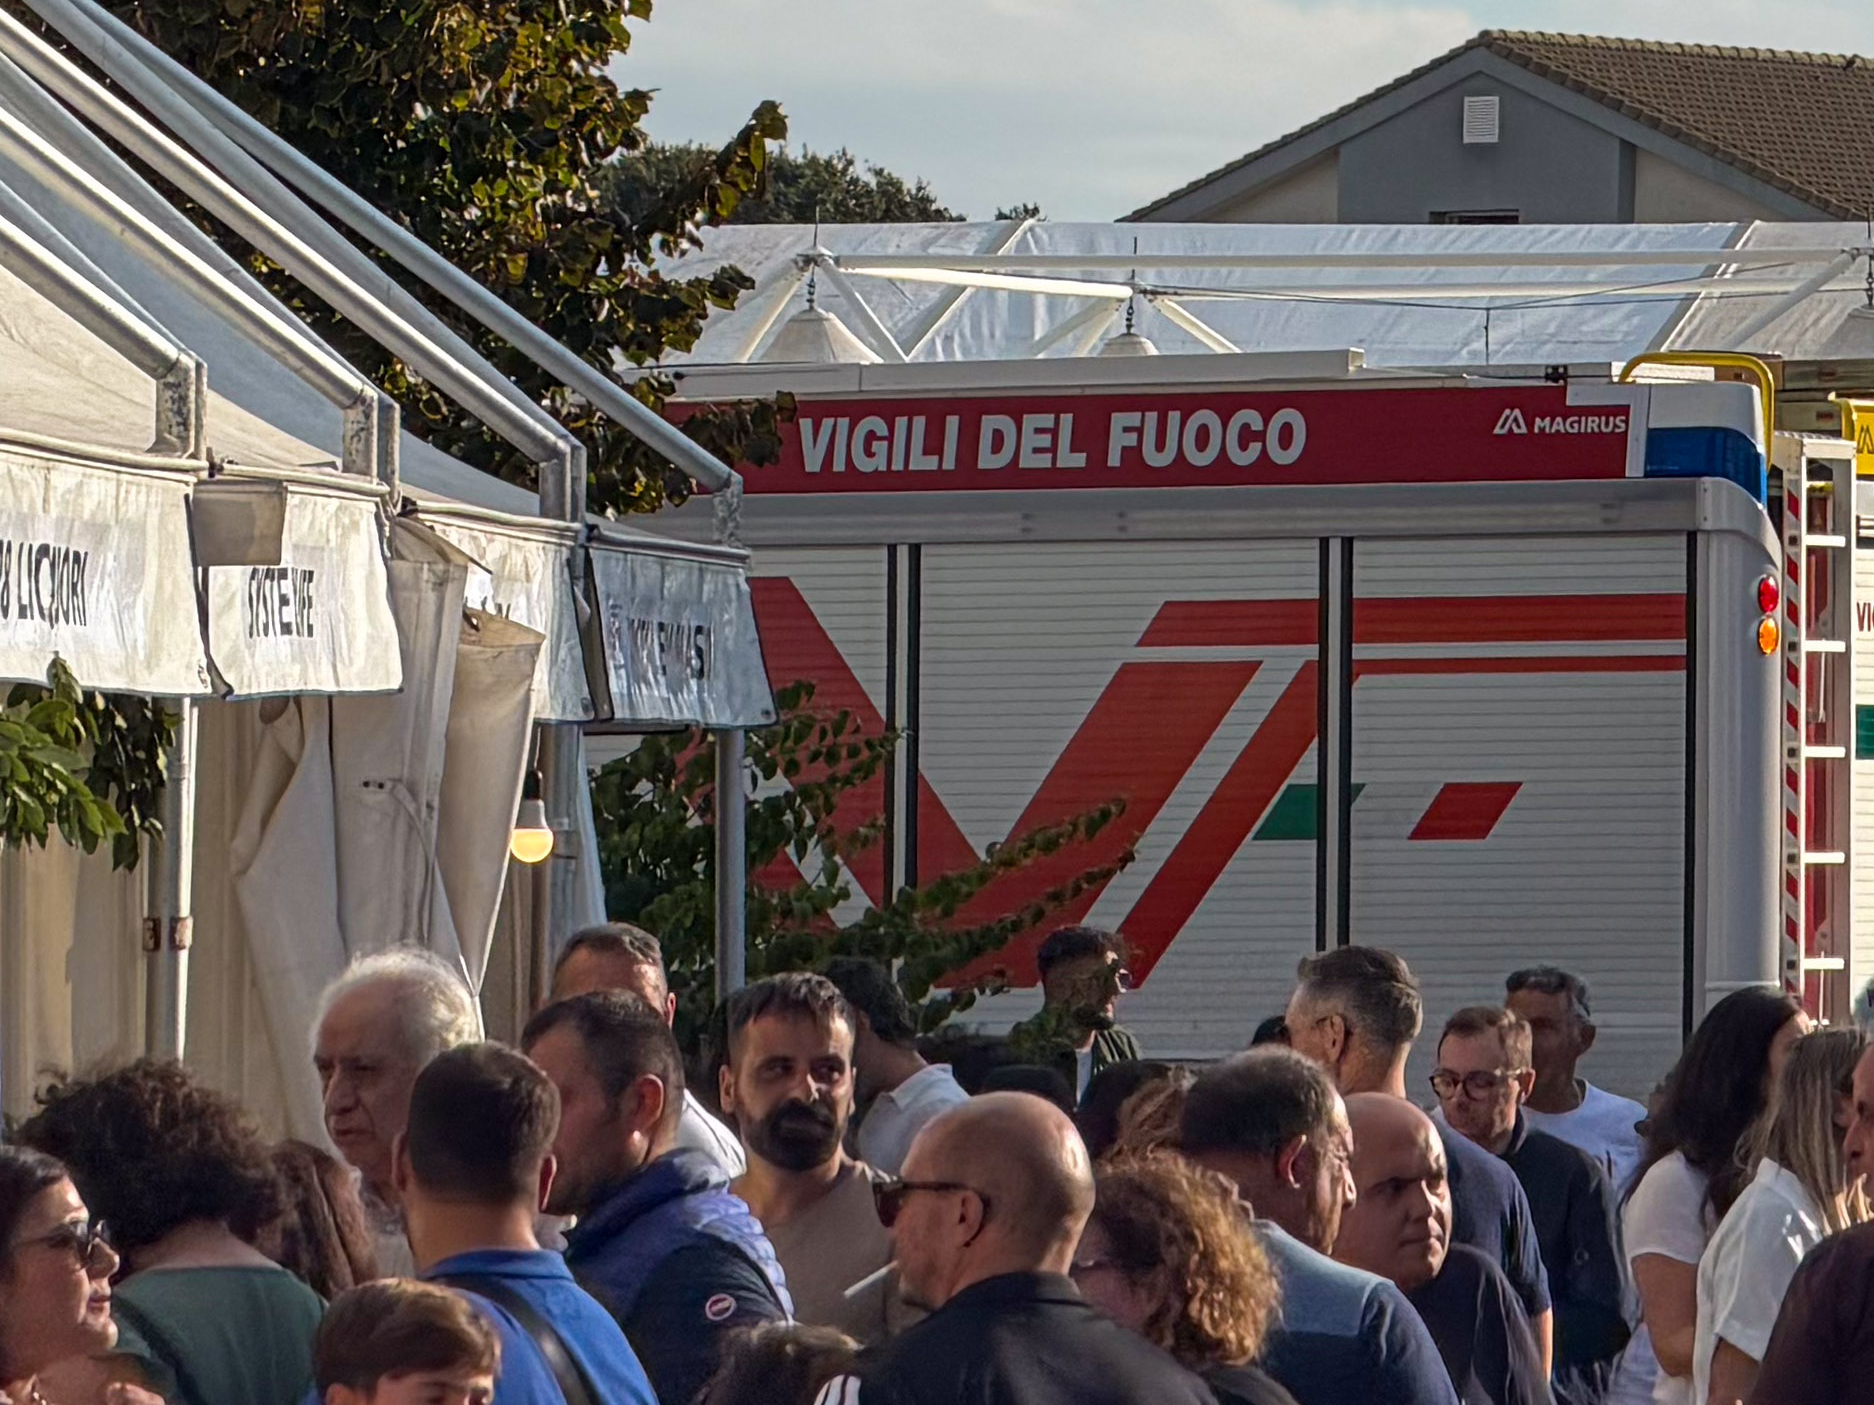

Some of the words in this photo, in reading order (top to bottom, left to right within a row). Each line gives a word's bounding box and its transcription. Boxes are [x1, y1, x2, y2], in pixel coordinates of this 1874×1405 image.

[800, 415, 959, 474] VIGILI
[977, 412, 1087, 471] DEL
[1107, 407, 1307, 468] FUOCO
[1534, 413, 1627, 436] MAGIRUS
[18, 542, 88, 629] LIQUORI
